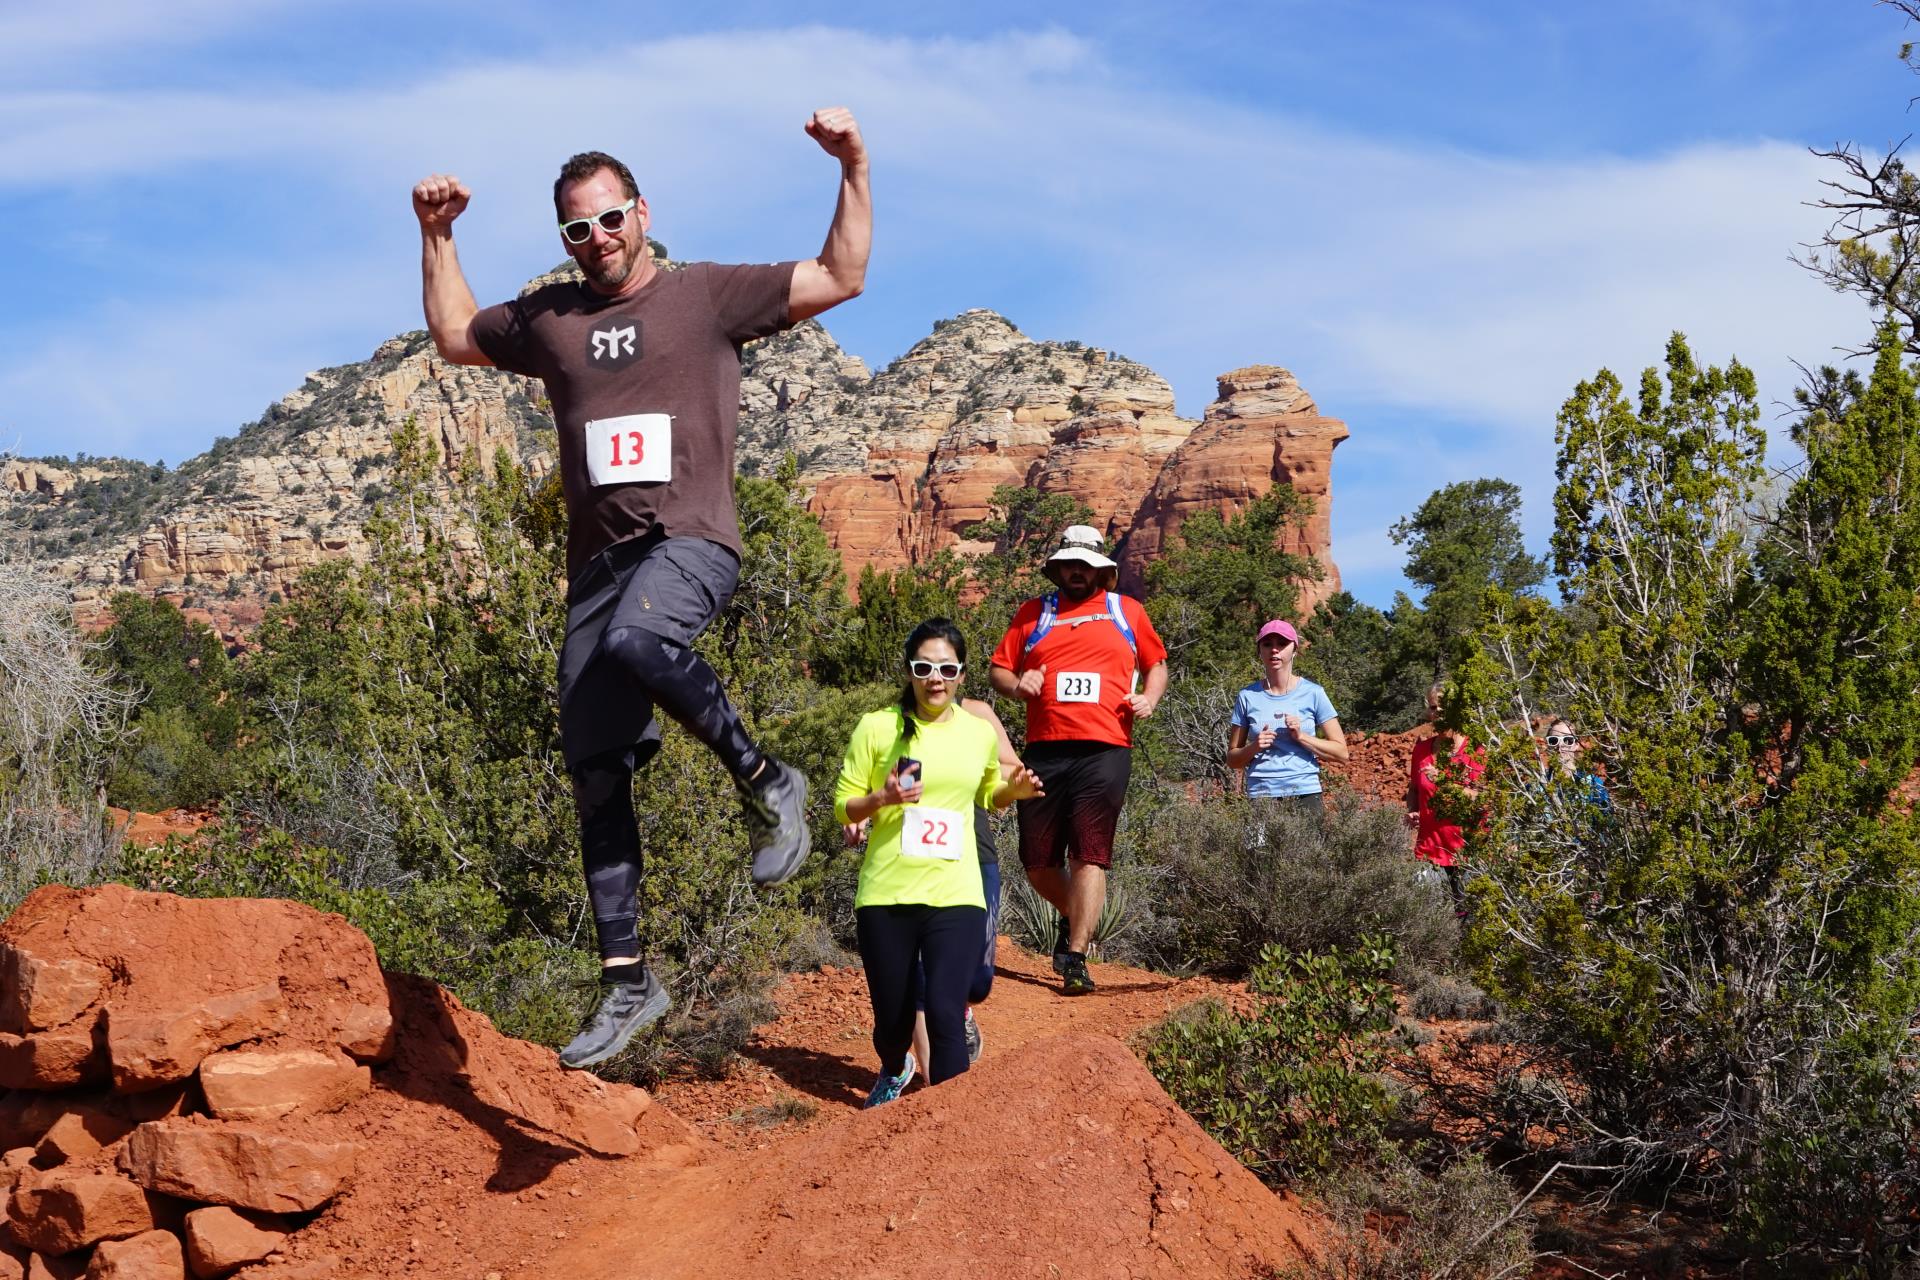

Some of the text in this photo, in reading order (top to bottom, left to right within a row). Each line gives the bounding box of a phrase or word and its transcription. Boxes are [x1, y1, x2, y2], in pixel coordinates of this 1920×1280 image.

[610, 431, 644, 466] 13
[1064, 677, 1092, 696] 233
[921, 820, 948, 846] 22
